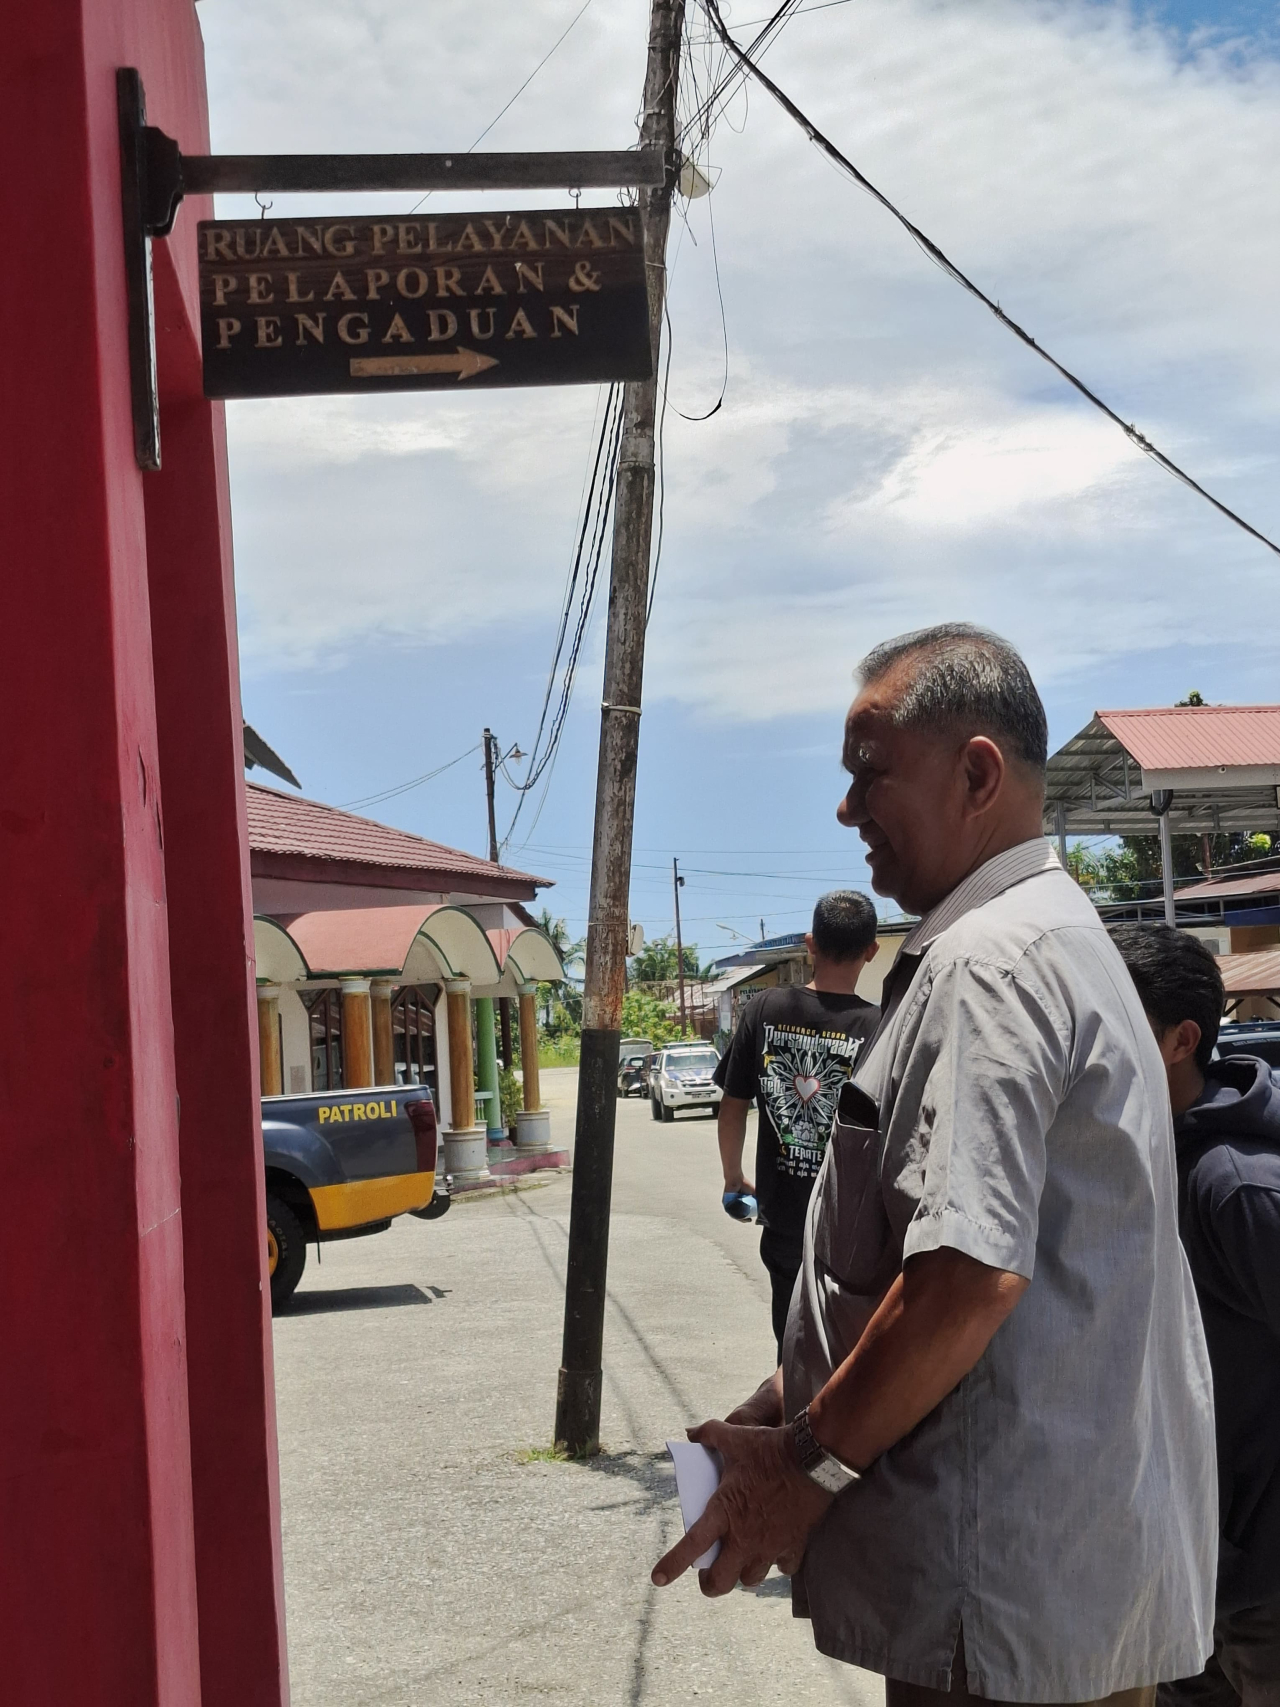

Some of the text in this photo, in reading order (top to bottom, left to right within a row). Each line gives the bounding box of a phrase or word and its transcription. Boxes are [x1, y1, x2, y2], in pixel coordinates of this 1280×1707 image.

[203, 216, 636, 262] RUANG PELAYANAN
[212, 260, 602, 306] PELAPORAN &
[216, 304, 581, 349] PENGADUAN
[318, 1100, 398, 1125] PATROLI
[788, 1145, 822, 1164] TERATE
